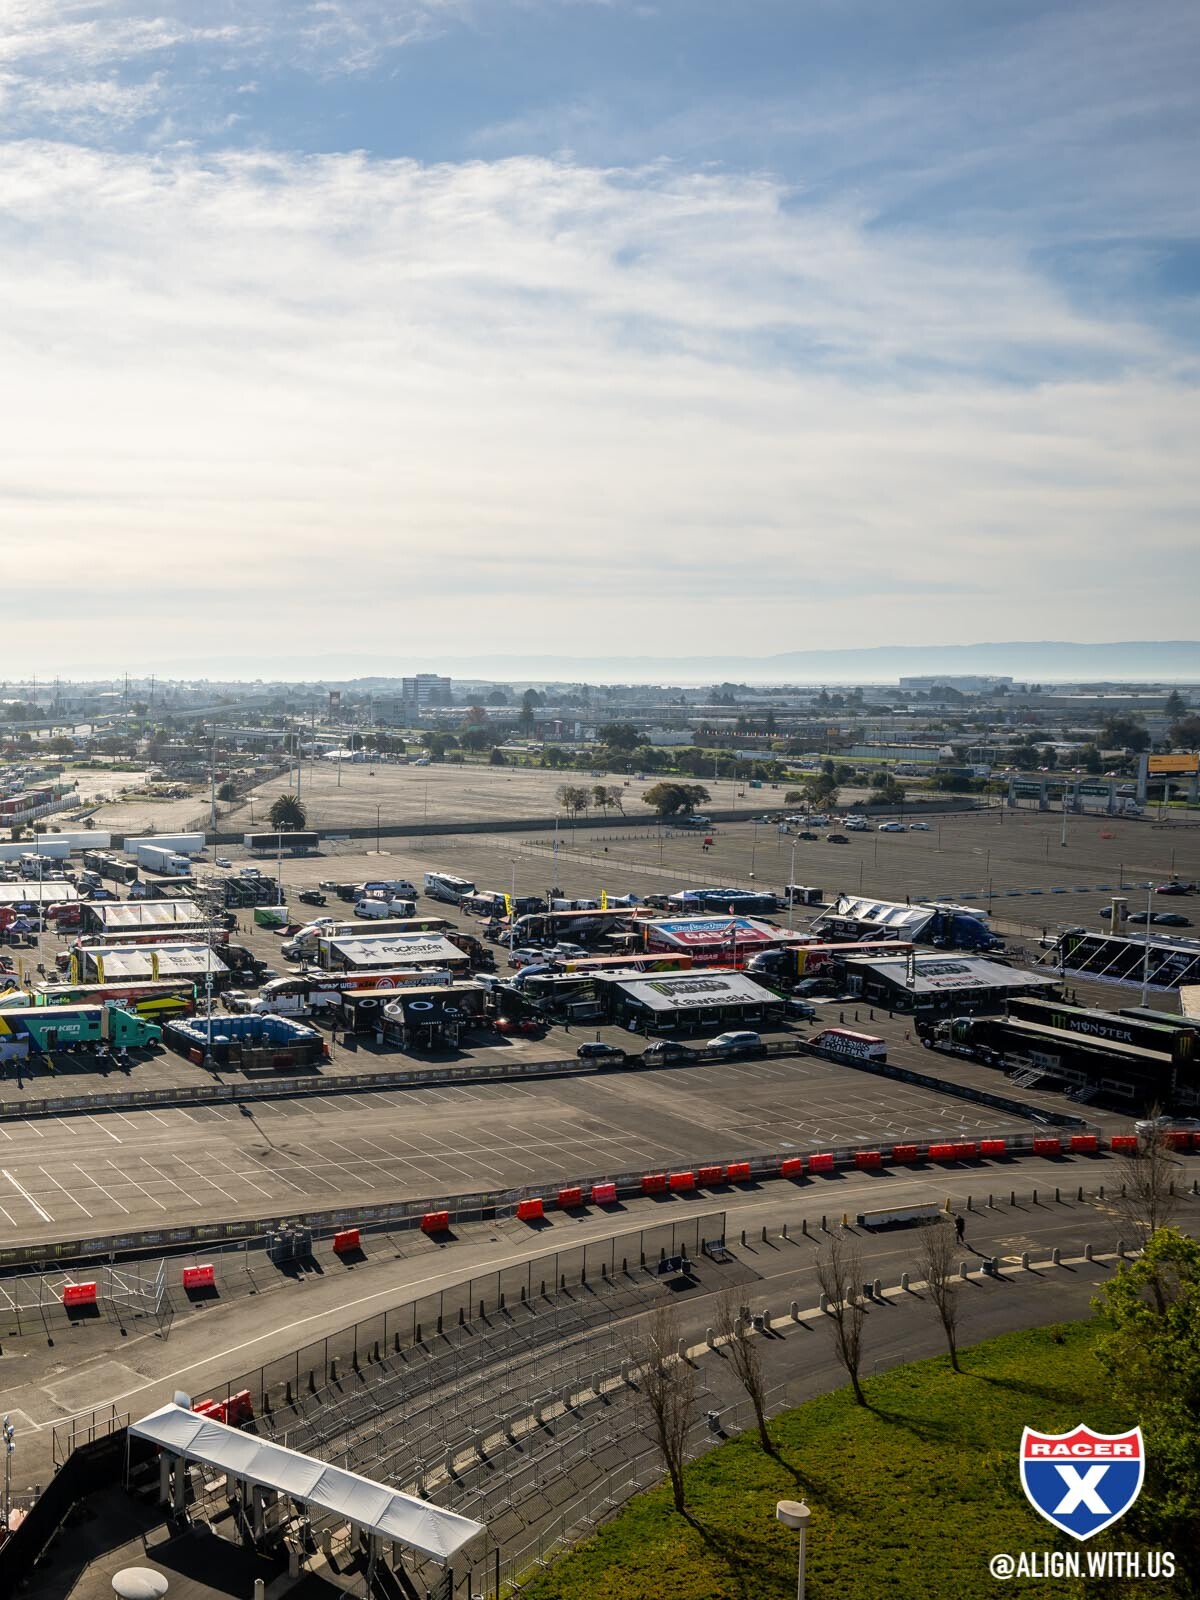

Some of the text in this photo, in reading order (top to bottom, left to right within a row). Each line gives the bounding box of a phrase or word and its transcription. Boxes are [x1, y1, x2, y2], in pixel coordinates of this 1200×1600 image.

[382, 943, 444, 952] ROCKSTAR
[668, 993, 756, 1007] Kawasaki
[1070, 1020, 1133, 1042] MONSTER
